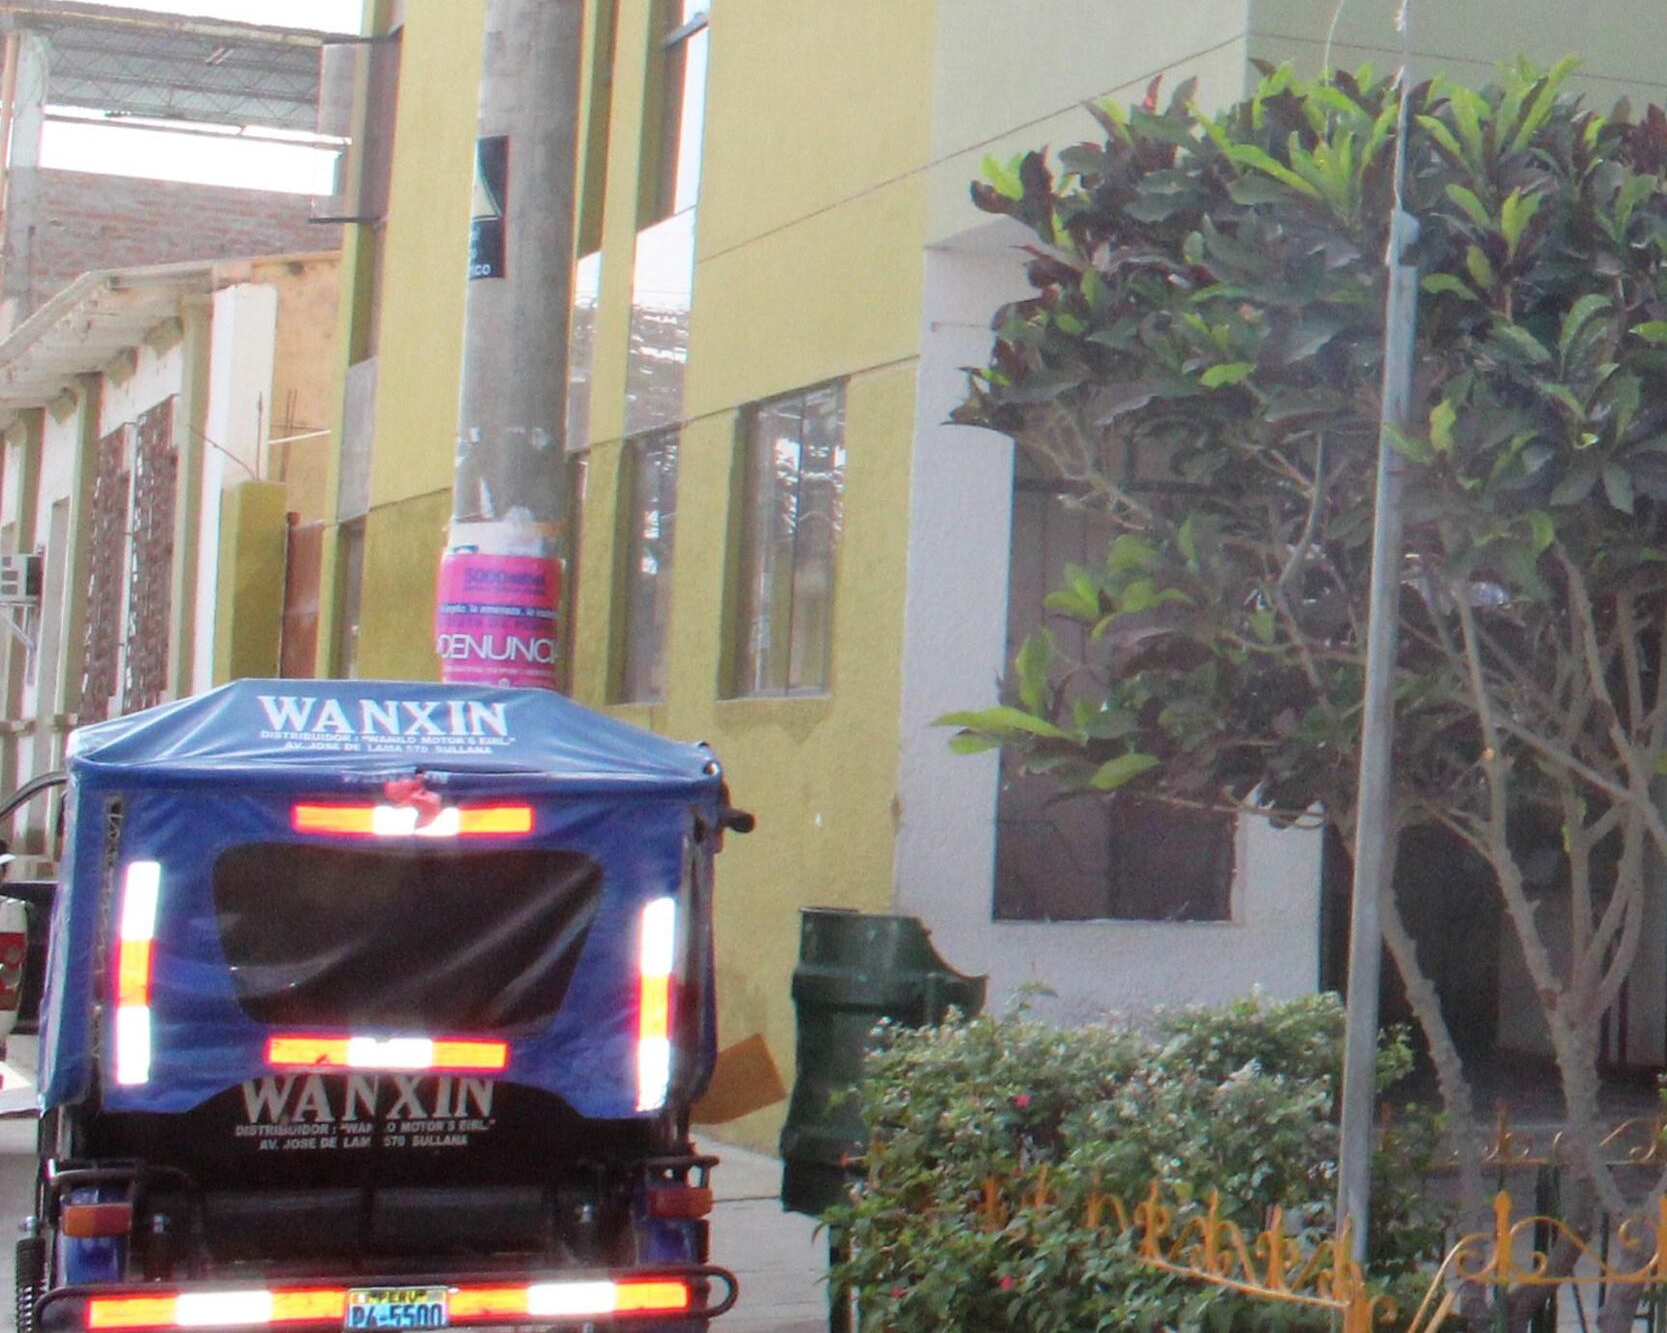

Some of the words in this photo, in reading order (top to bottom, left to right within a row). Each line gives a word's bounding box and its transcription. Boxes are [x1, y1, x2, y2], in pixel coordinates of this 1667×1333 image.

[257, 695, 509, 737] WANXIN
[243, 1074, 496, 1124] WANXIN
[320, 1136, 337, 1149] DE
